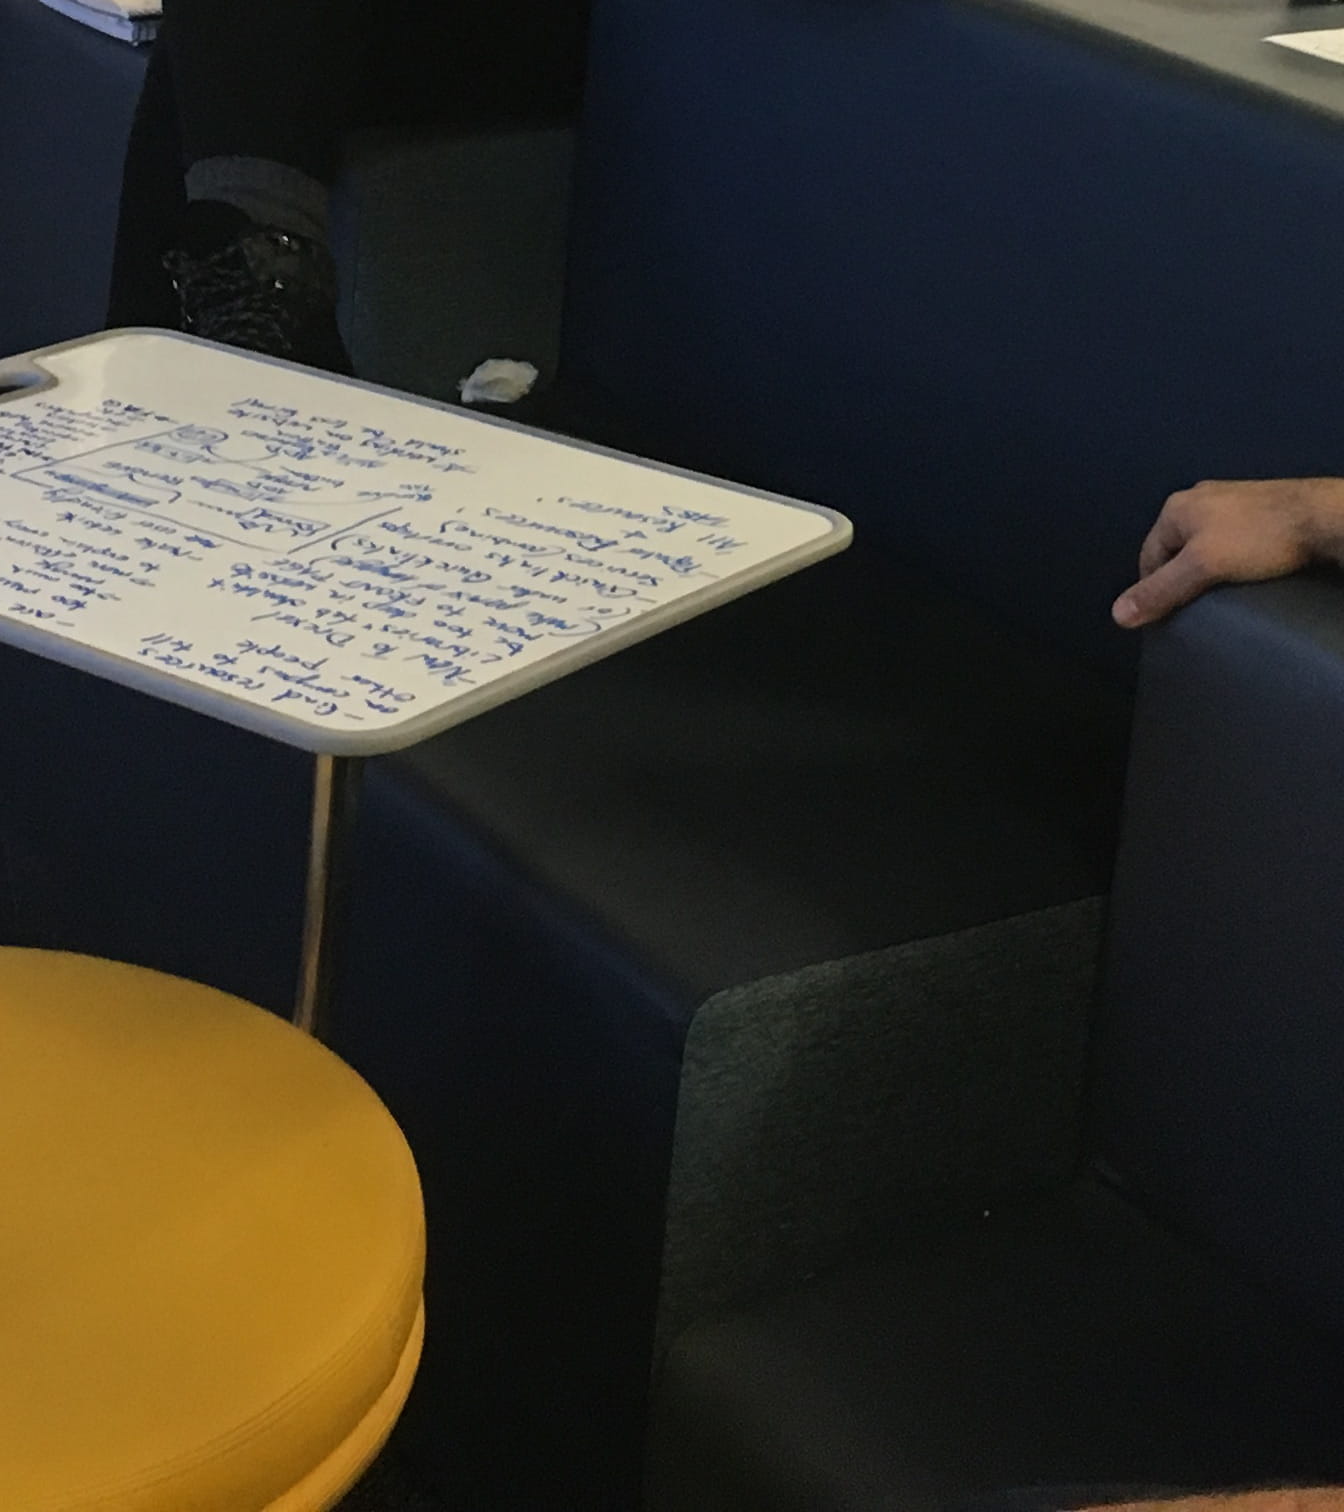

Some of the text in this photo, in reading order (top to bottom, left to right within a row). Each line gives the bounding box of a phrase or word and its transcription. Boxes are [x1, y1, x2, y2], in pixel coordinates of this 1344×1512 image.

[8, 603, 55, 618] are
[51, 595, 87, 611] too
[436, 604, 465, 616] to
[251, 611, 354, 647] Drexel
[433, 620, 472, 638] too
[140, 633, 192, 652] tell
[495, 636, 523, 656] be
[212, 653, 238, 665] to
[236, 640, 327, 670] people
[138, 647, 264, 689] resources
